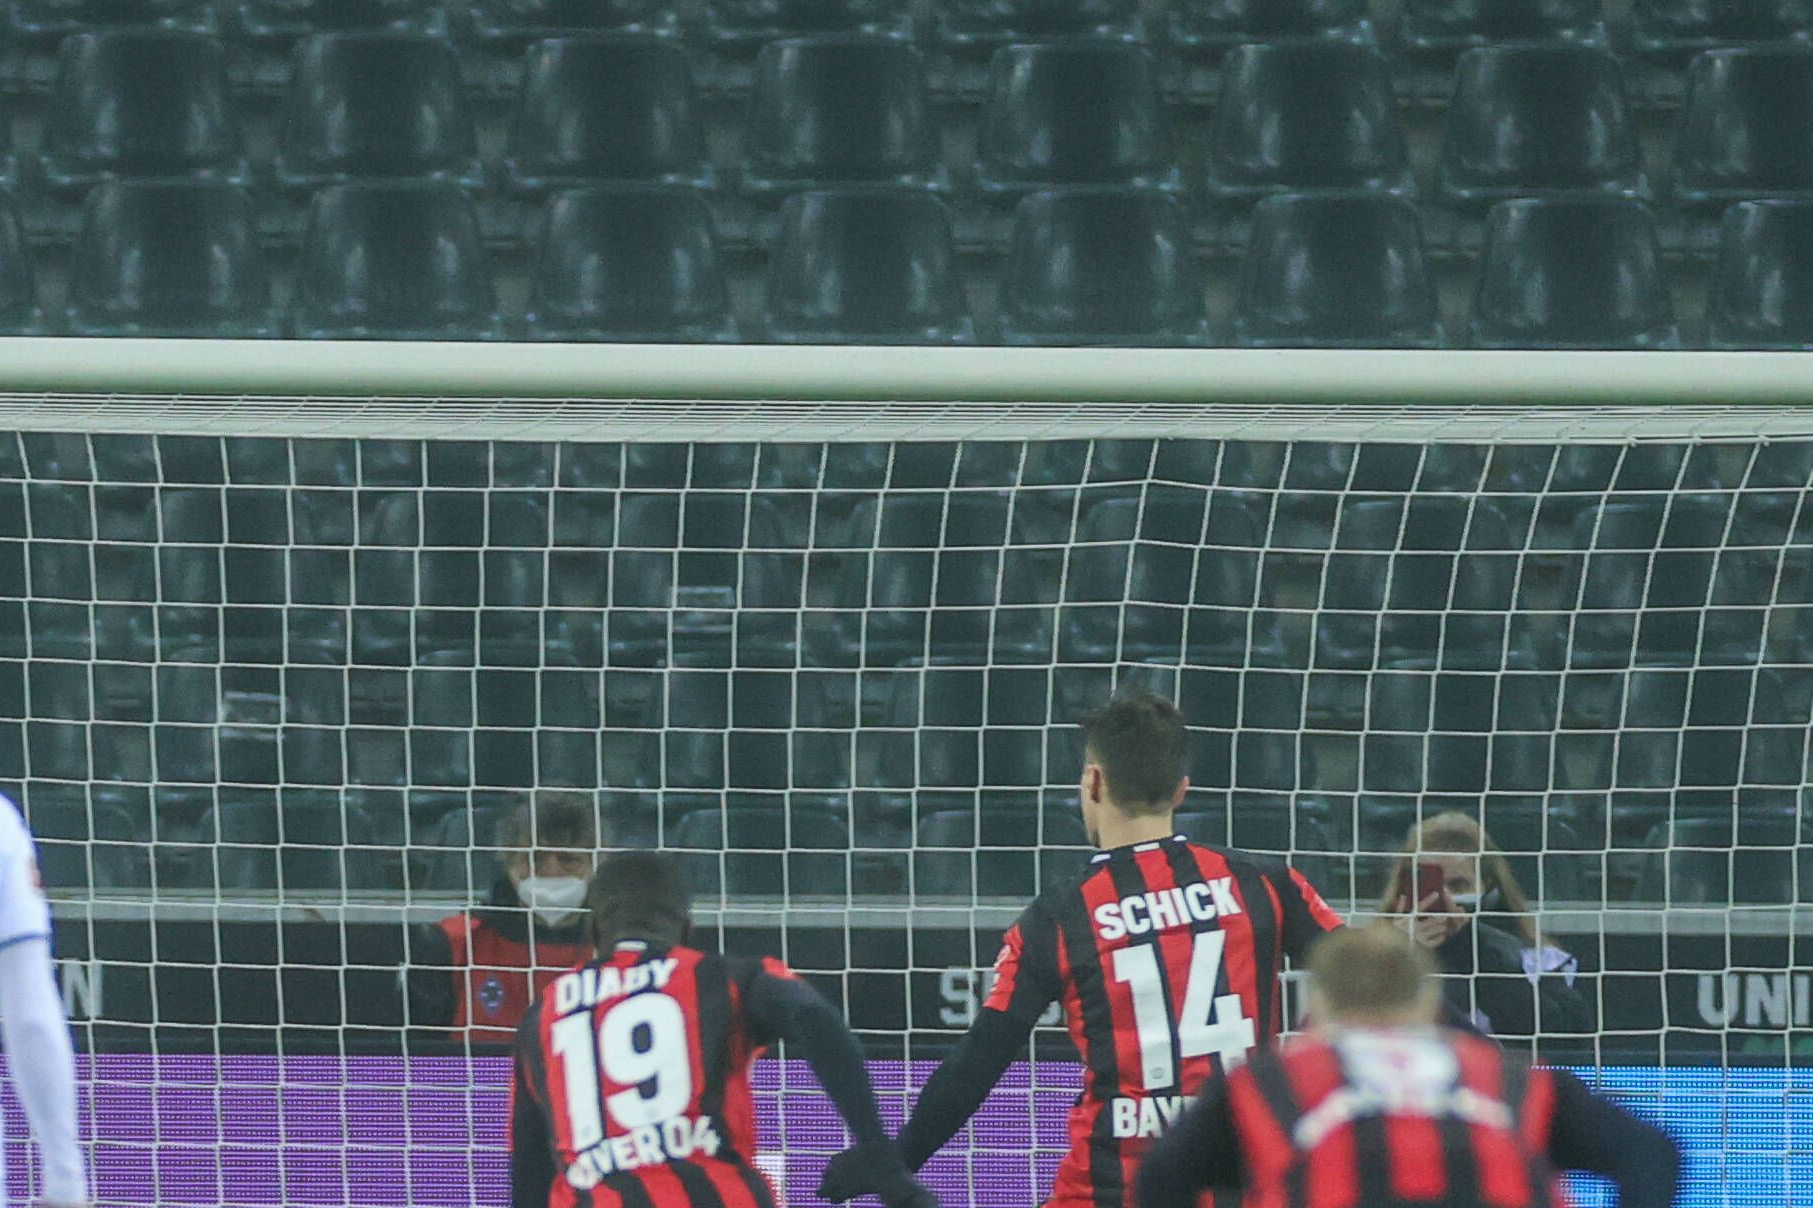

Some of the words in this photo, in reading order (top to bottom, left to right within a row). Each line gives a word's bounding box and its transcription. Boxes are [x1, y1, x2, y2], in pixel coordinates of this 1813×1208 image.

[1094, 876, 1242, 941] SCHICK
[554, 957, 680, 1016] DIABY
[1112, 930, 1256, 1091] 14
[551, 991, 693, 1153] 19
[1112, 1095, 1200, 1138] BAY
